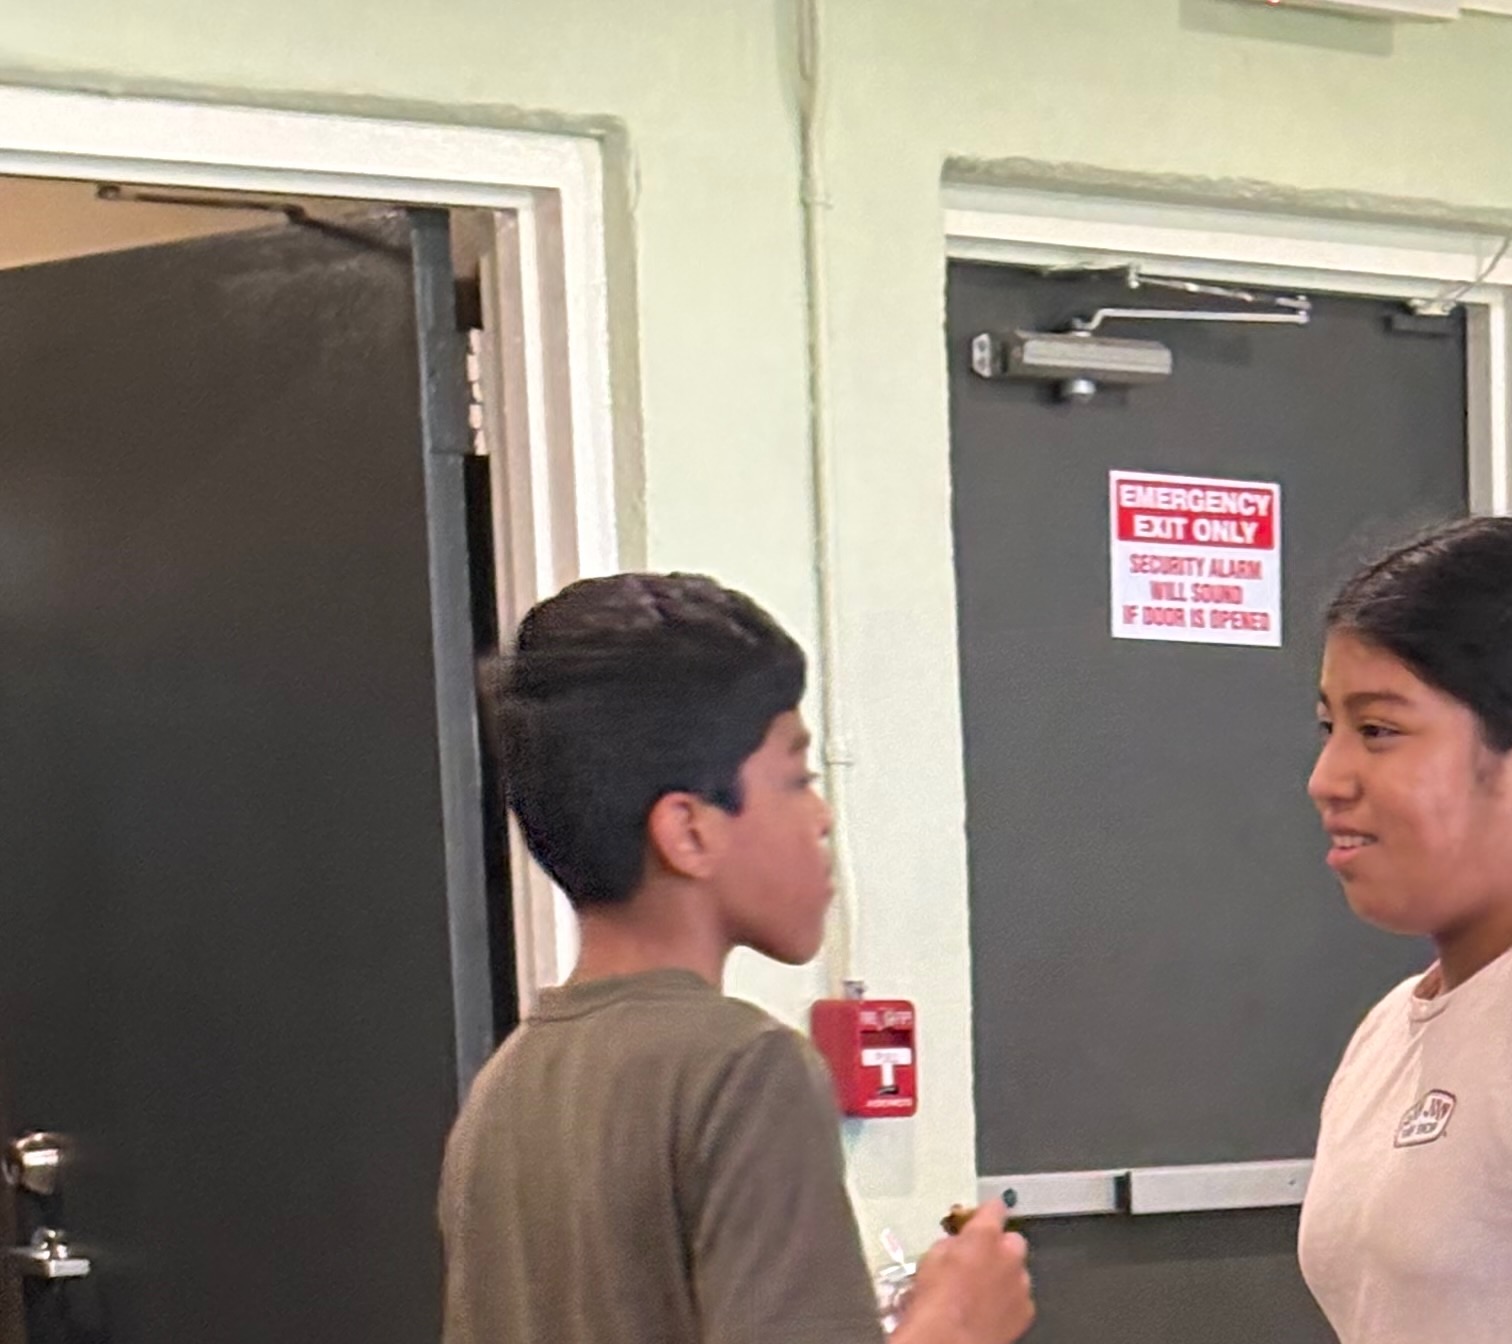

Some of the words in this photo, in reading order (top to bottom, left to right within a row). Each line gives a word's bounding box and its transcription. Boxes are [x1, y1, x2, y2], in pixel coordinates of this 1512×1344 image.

[1119, 484, 1272, 516] EMERGENCY
[1133, 514, 1188, 541] EXIT
[1192, 518, 1259, 544] ONLY
[1129, 553, 1205, 577] SECURITY
[1208, 558, 1263, 580] ALARM
[1150, 580, 1187, 602] WILL
[1191, 583, 1244, 605] SOUND
[1122, 604, 1139, 625] IF
[1142, 606, 1186, 627] DOOR
[1190, 608, 1205, 628] IS
[1210, 610, 1271, 631] OPENED
